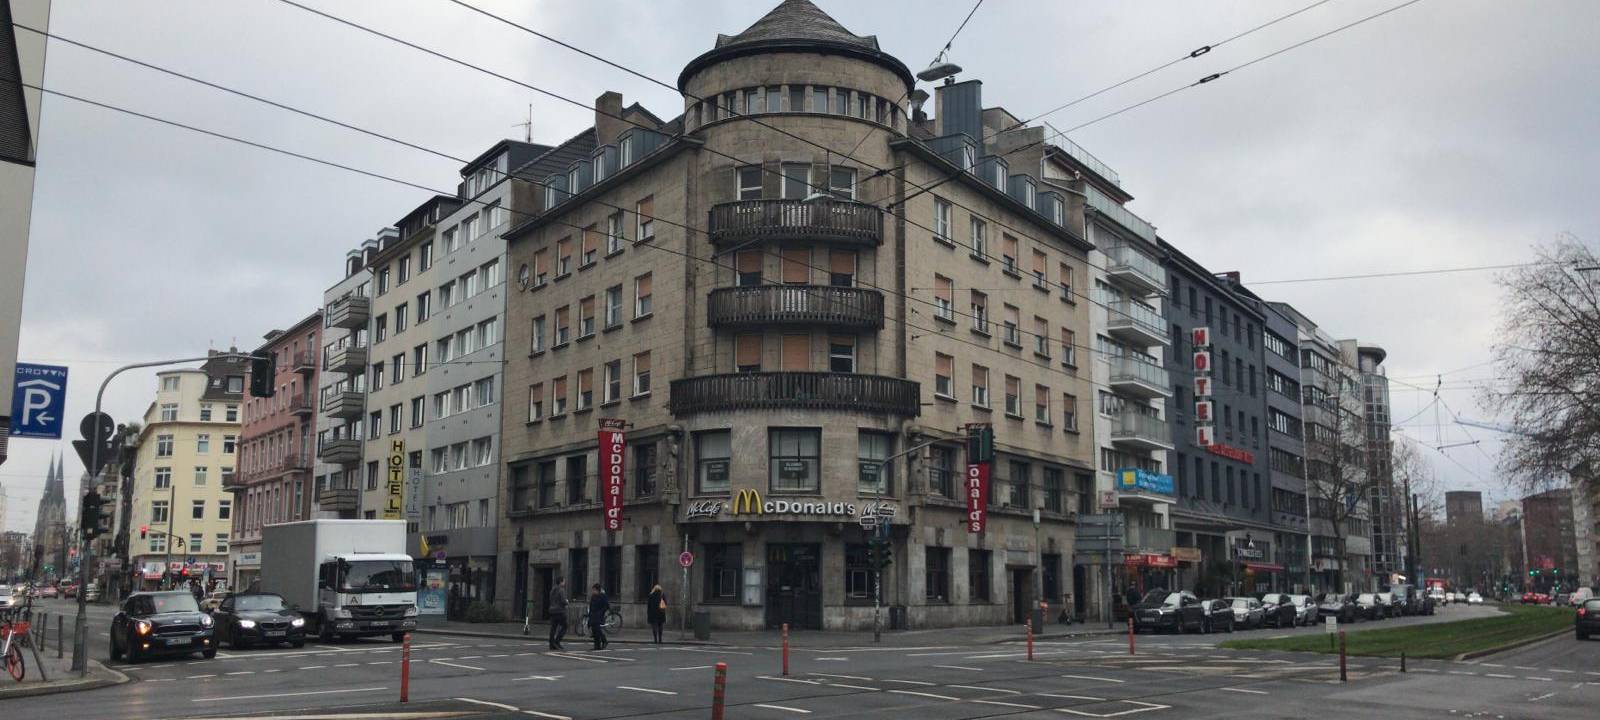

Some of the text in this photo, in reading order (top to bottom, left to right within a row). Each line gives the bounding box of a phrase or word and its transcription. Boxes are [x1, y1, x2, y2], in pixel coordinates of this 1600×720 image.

[22, 388, 51, 426] P
[1194, 329, 1210, 445] HOTEL
[389, 440, 403, 510] HOTEL
[608, 432, 624, 529] McDonald's
[734, 488, 856, 516] McDonald's
